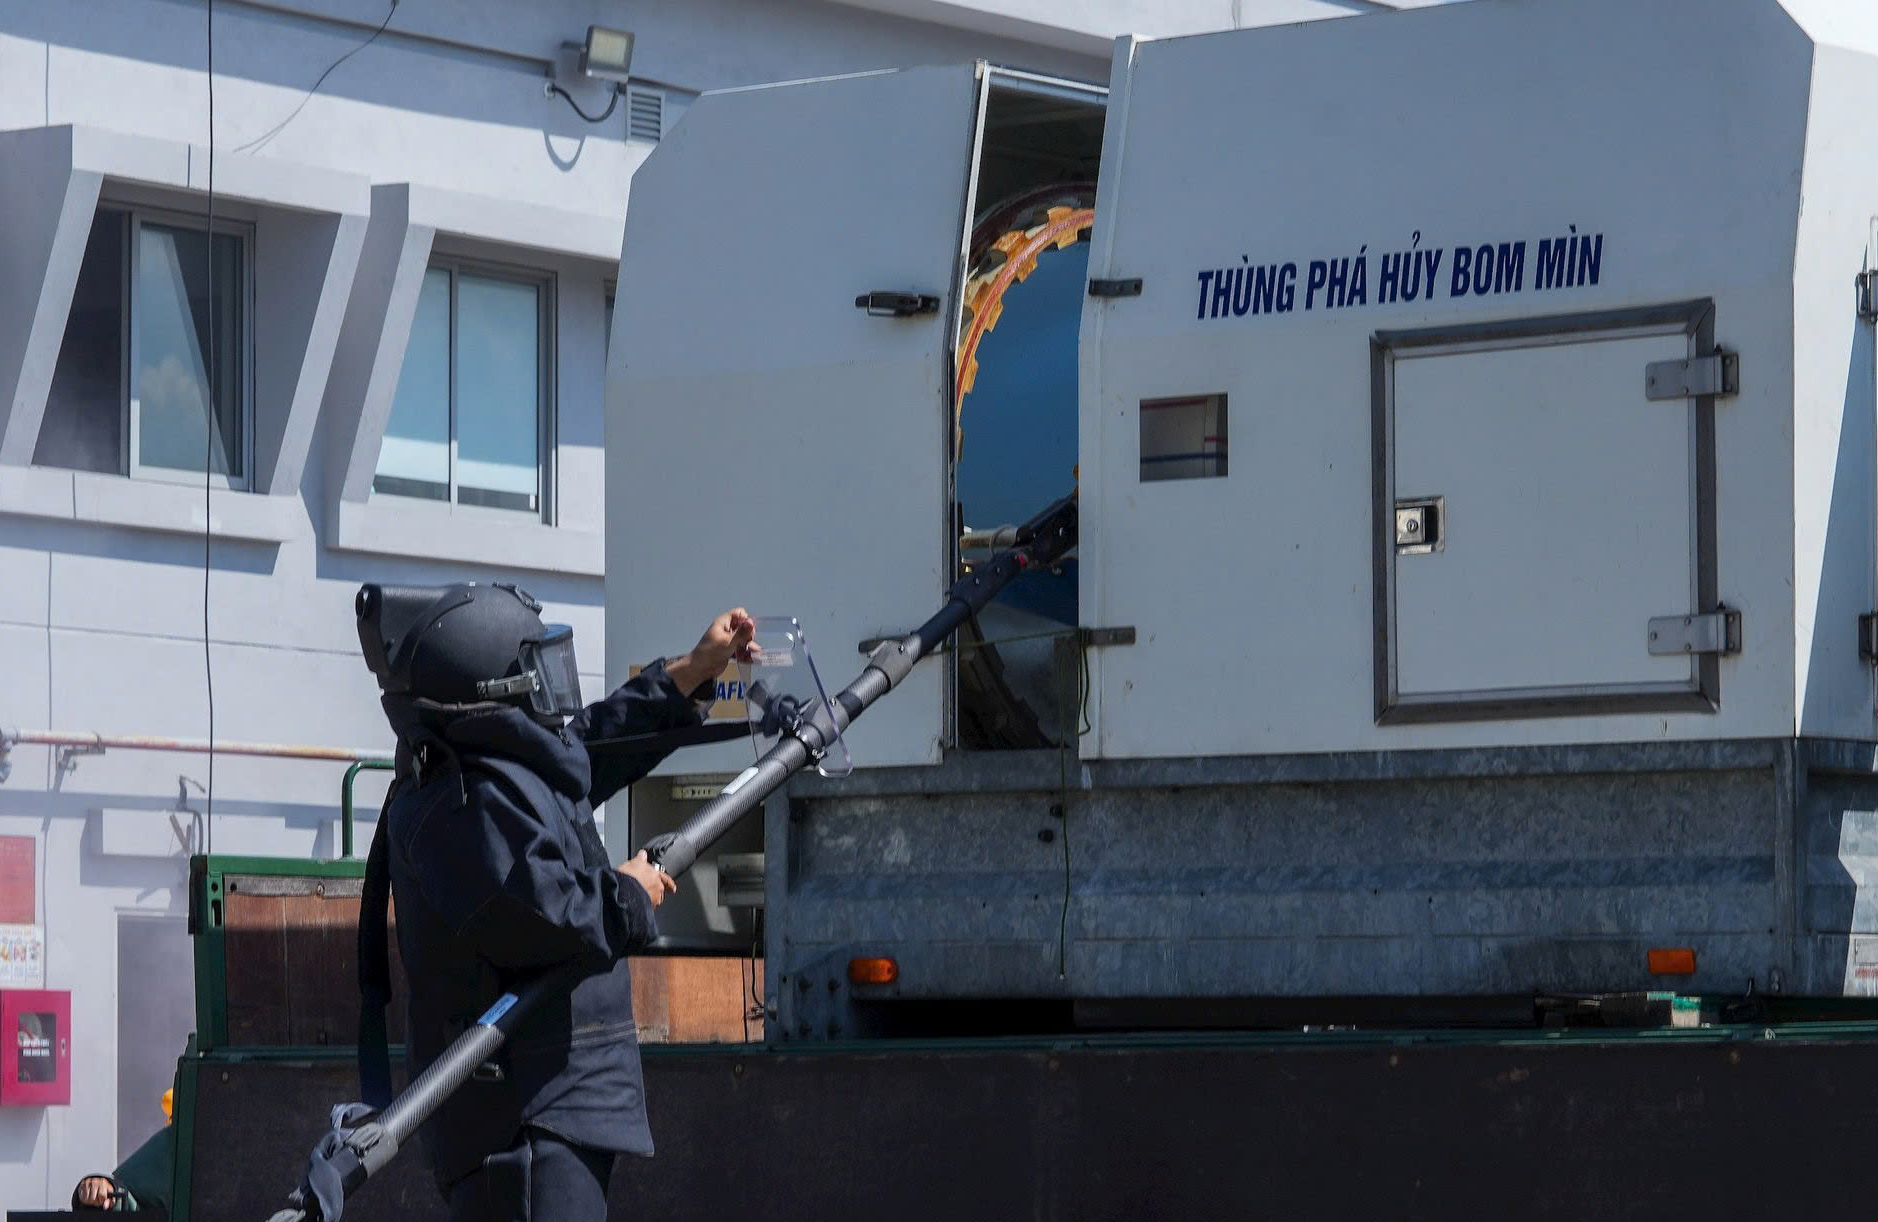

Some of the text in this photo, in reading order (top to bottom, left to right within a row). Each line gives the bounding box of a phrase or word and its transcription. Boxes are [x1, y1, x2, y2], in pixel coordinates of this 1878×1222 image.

[1198, 224, 1603, 320] THÙNG PHÁ HỦY BOM MÌN
